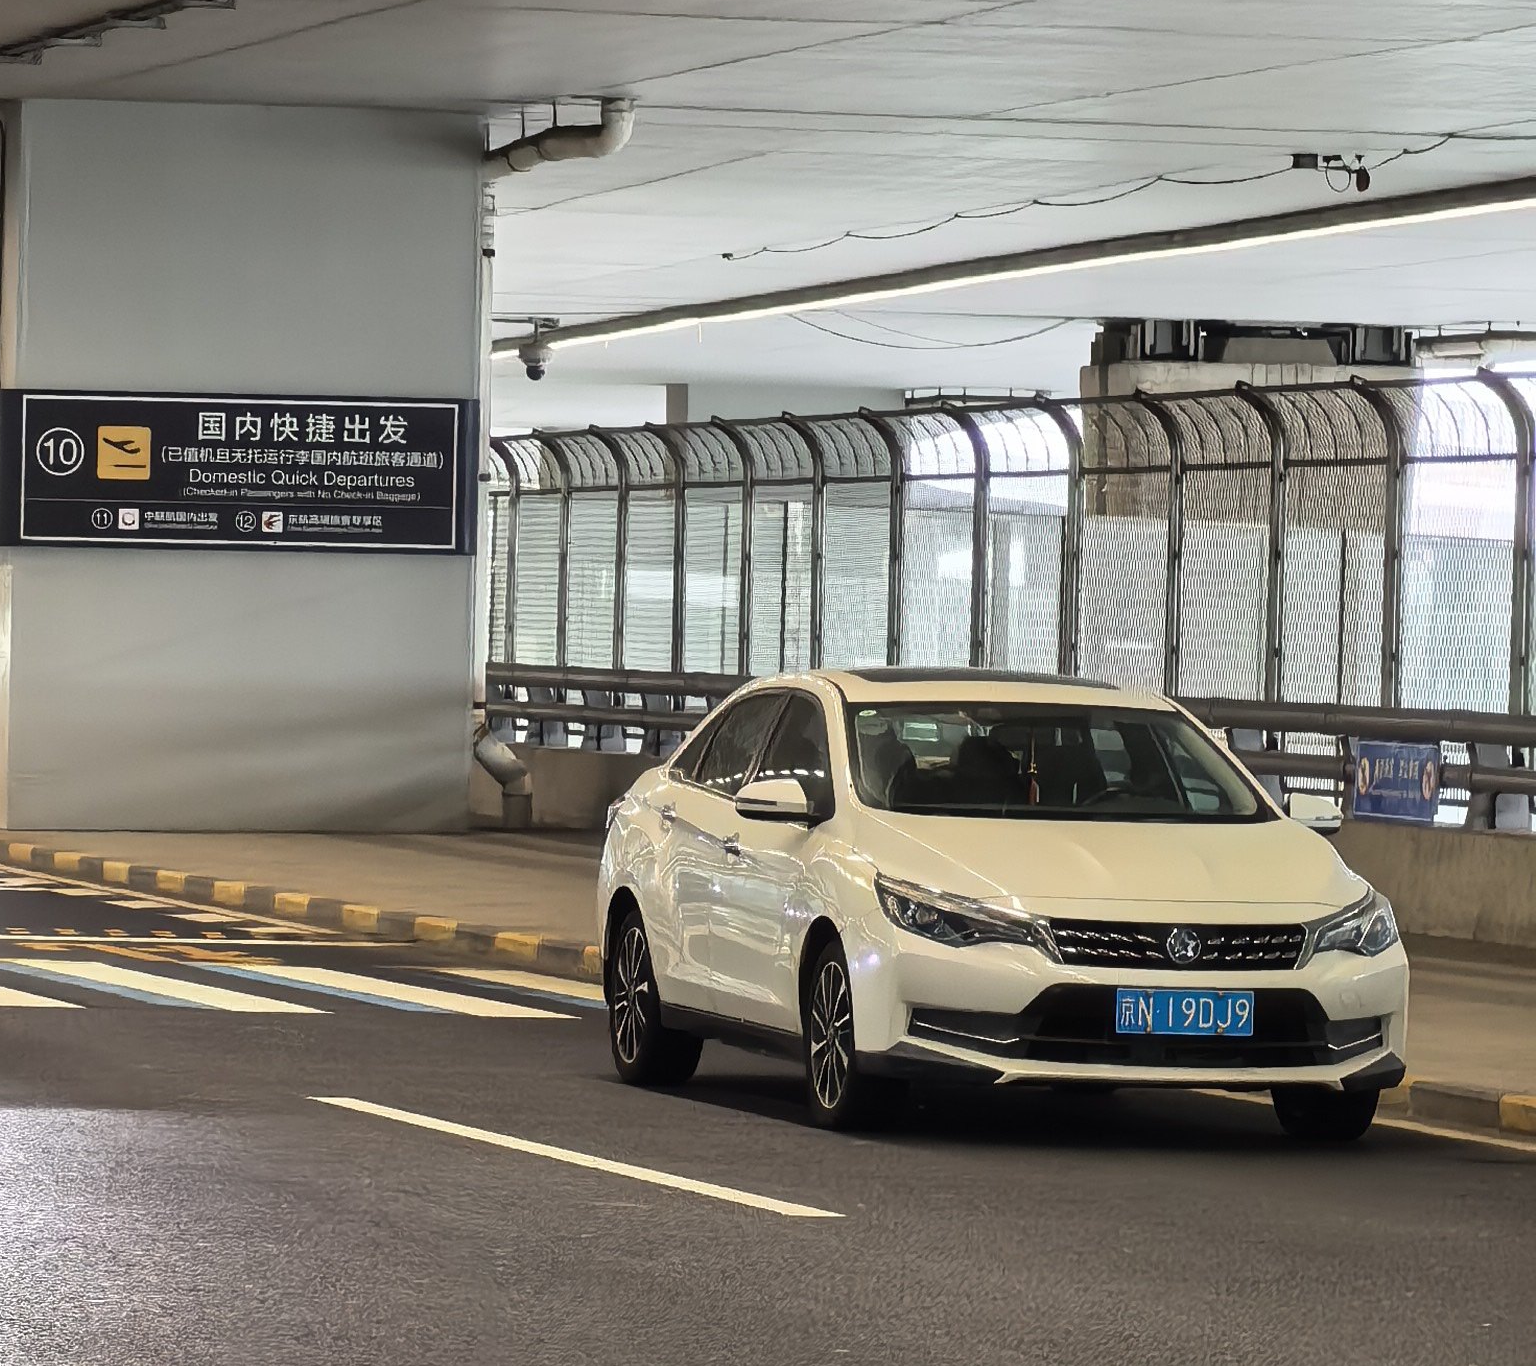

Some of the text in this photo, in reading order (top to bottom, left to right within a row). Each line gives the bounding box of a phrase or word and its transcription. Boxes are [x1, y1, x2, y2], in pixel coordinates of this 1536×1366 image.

[198, 412, 409, 445] 国内快捷出发
[43, 438, 77, 465] 10
[189, 468, 415, 489] Domestic Quick Departures
